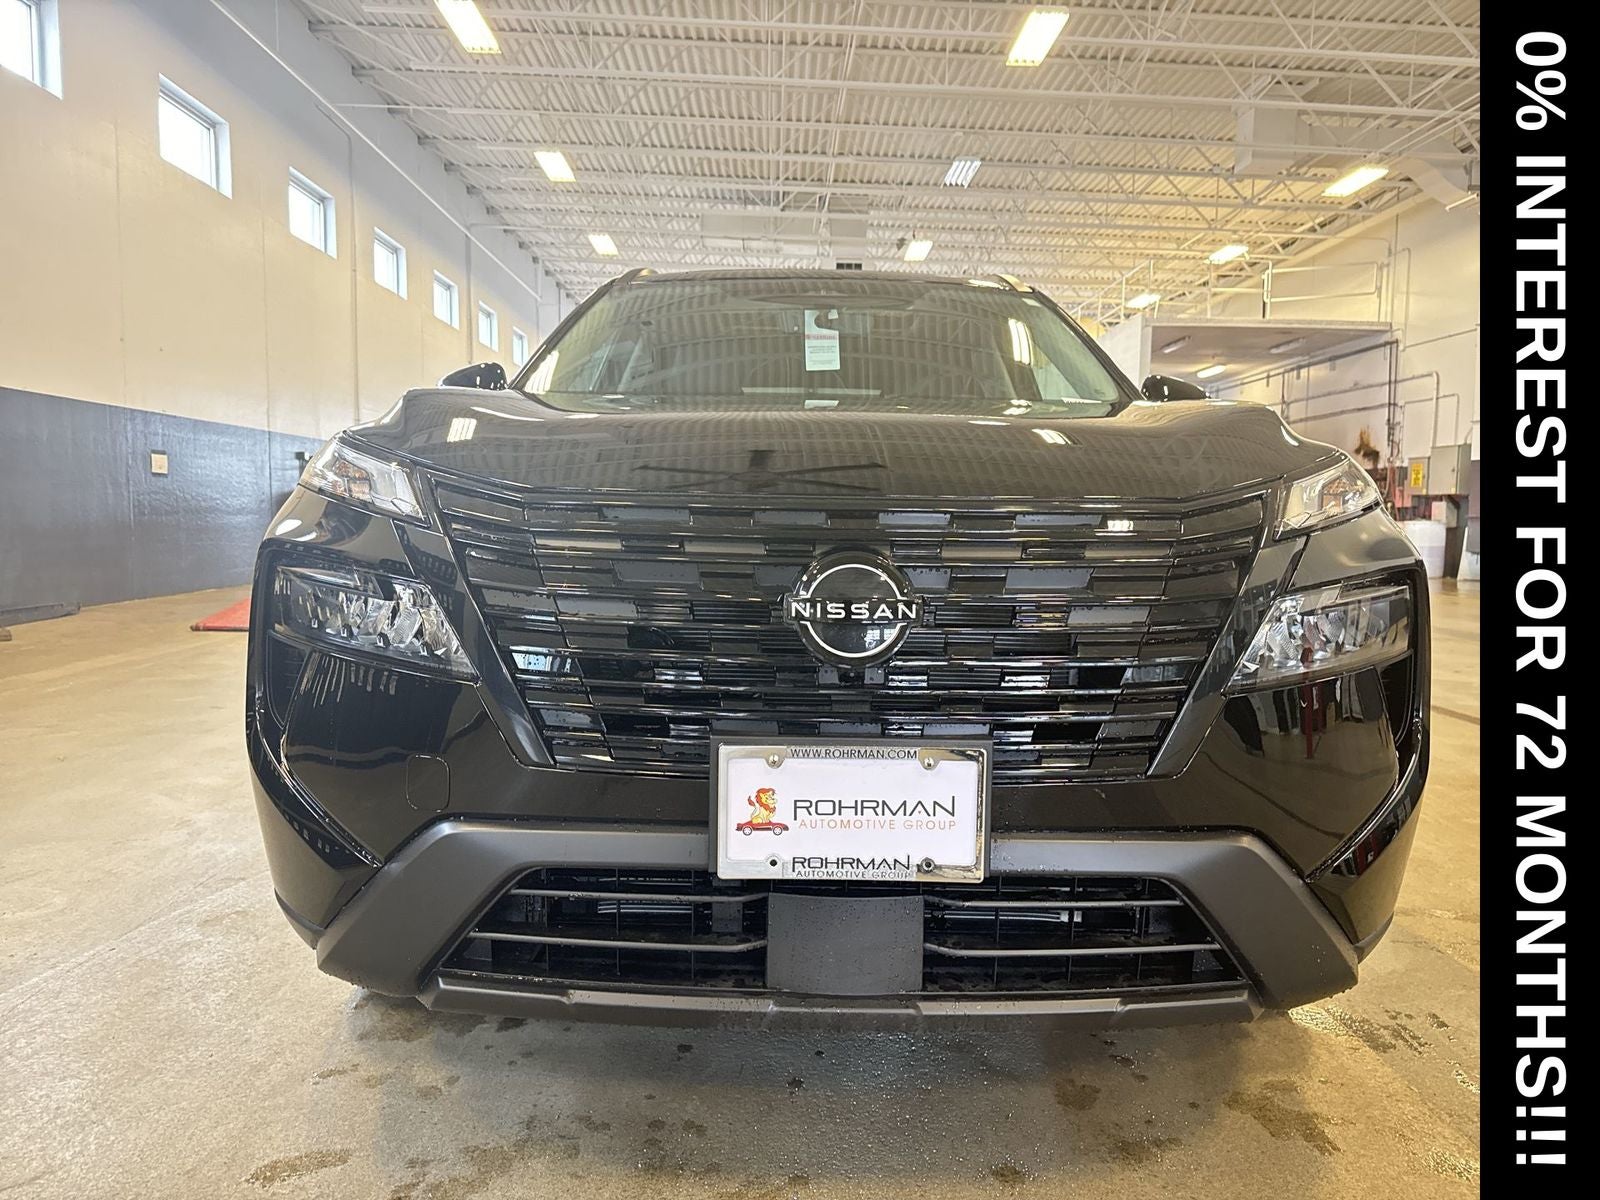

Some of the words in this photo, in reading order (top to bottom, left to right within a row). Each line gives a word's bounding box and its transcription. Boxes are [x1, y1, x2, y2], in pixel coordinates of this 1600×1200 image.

[791, 601, 917, 619] NISSAN
[790, 748, 918, 760] WWW.ROHRMAN.COM
[793, 796, 956, 821] ROHRMAN
[798, 819, 896, 830] AUTOMOTIVE
[903, 820, 957, 831] GROUP
[792, 854, 911, 873] ROHRMAN
[796, 870, 868, 879] AUTOMOTIVE
[871, 871, 911, 880] GROUP
